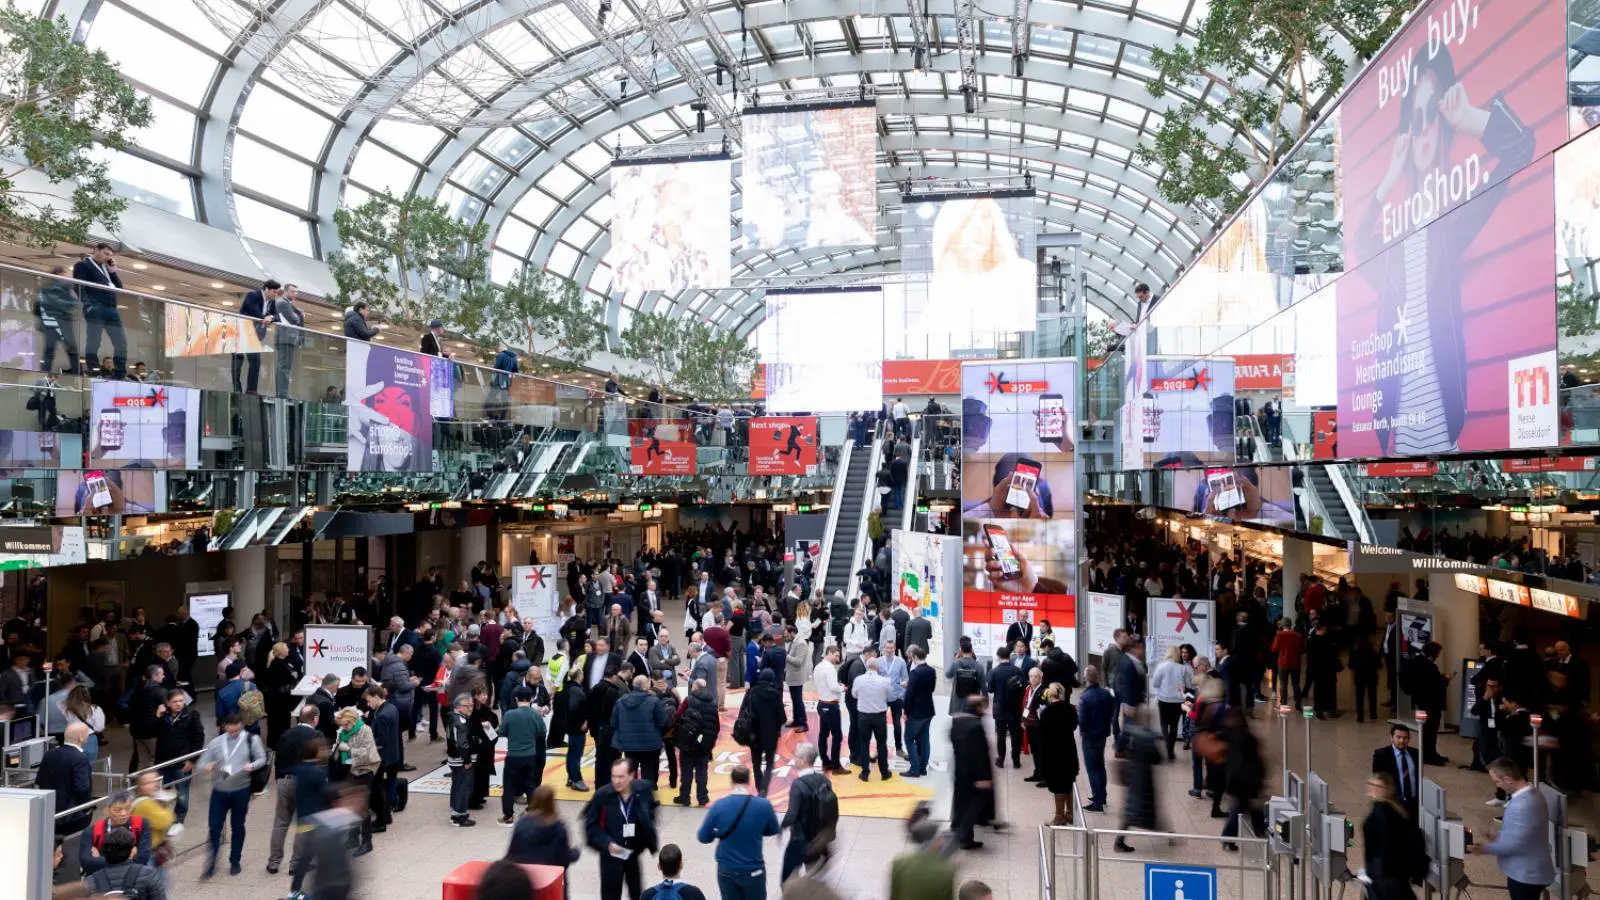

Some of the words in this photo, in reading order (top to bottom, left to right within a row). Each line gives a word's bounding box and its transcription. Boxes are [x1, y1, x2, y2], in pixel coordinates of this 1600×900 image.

[1378, 48, 1417, 110] Buy,
[1427, 0, 1478, 61] buy,
[1383, 153, 1489, 243] EuroShop.
[1352, 331, 1393, 360] EuroShop
[1356, 350, 1426, 385] Merchandising
[1011, 382, 1032, 393] app
[1352, 390, 1383, 413] Lounge
[1517, 414, 1536, 425] Messe
[369, 440, 413, 458] EuroShop!
[5, 541, 51, 551] Willkommen
[330, 644, 365, 653] EuroShop
